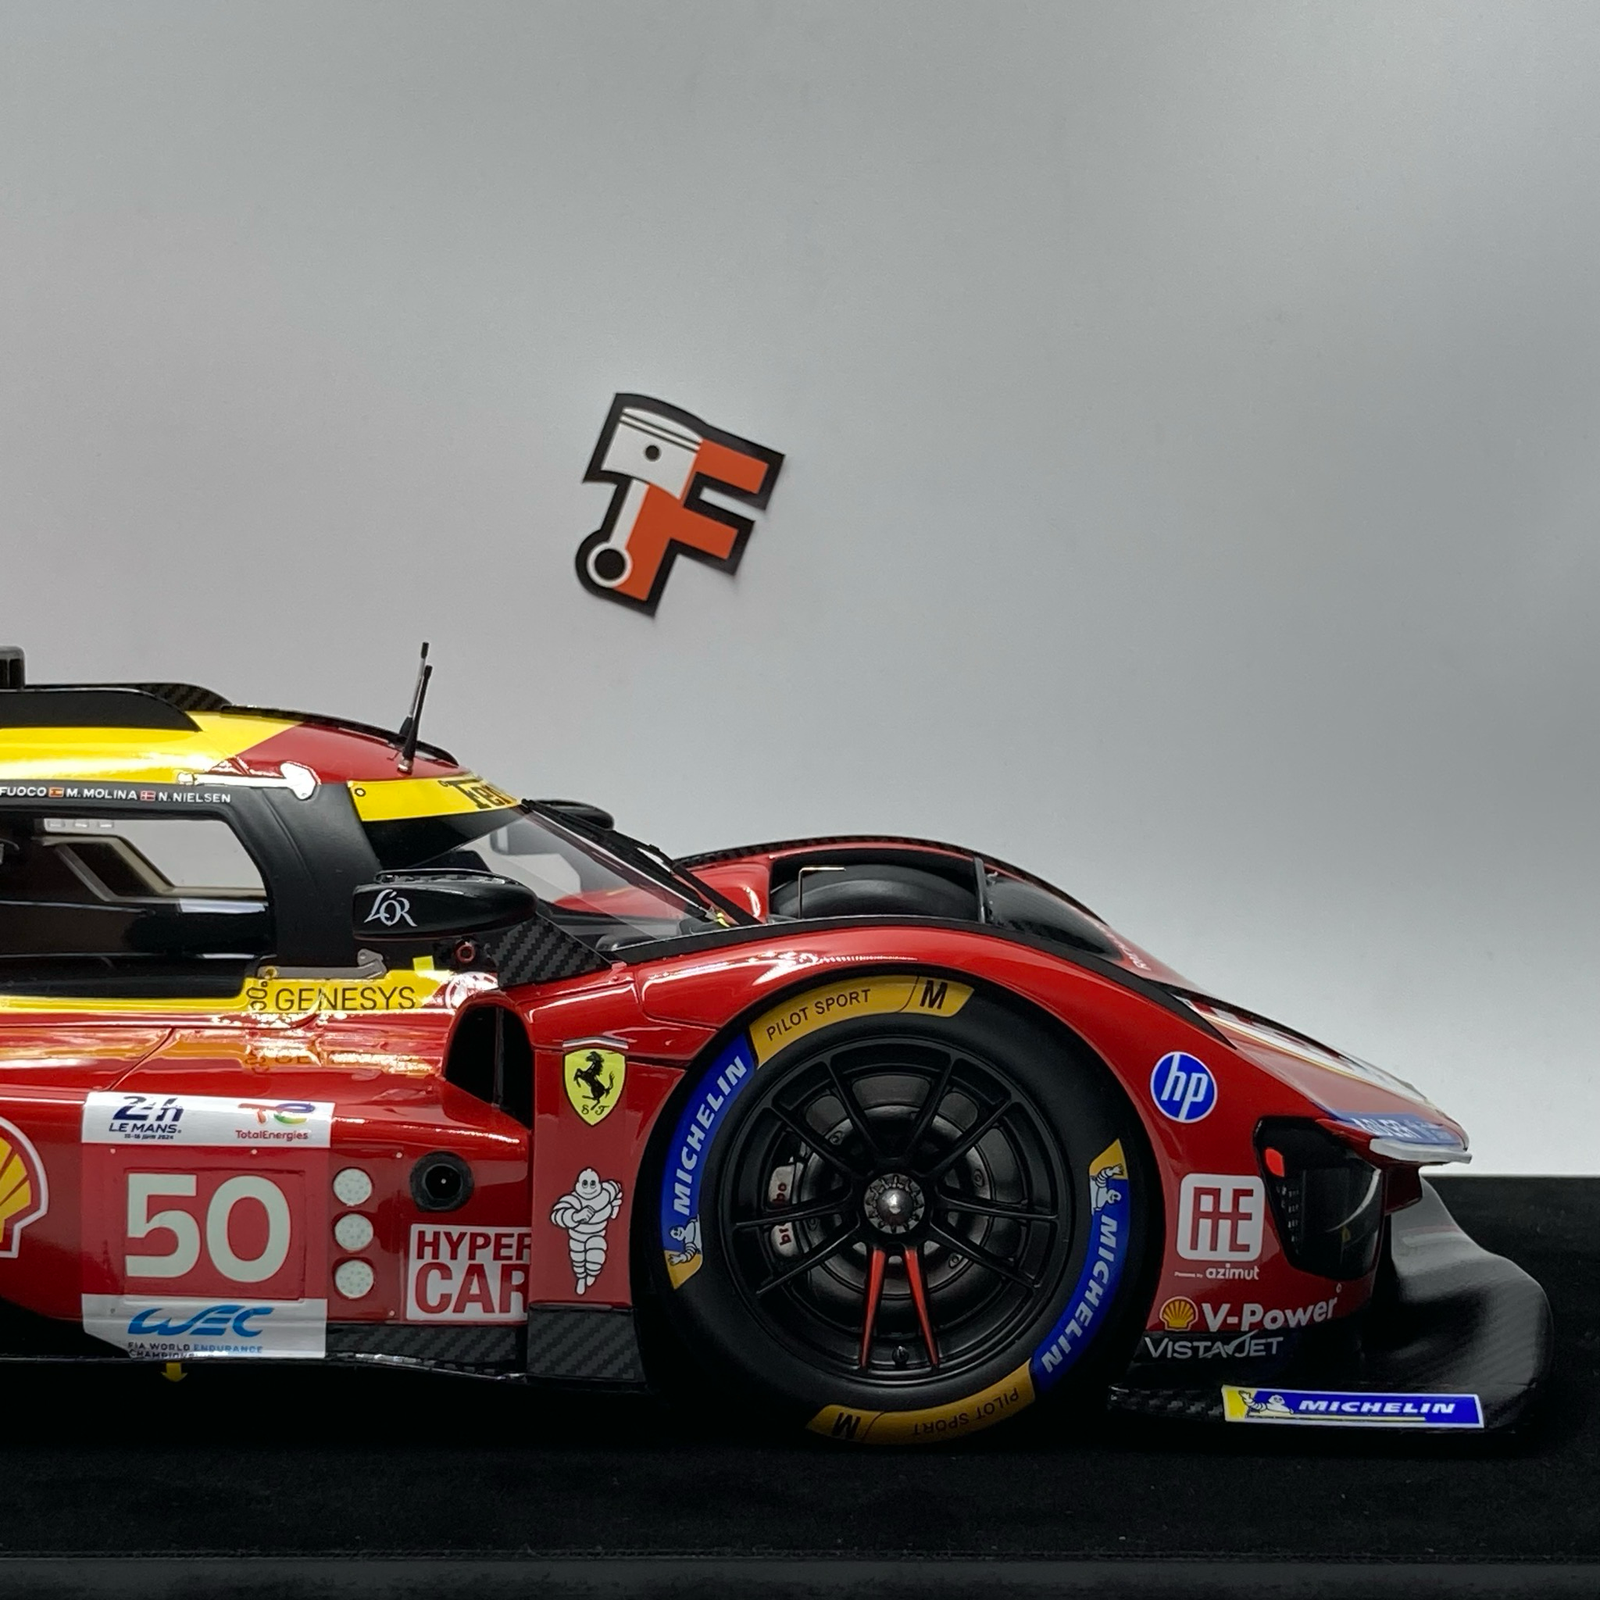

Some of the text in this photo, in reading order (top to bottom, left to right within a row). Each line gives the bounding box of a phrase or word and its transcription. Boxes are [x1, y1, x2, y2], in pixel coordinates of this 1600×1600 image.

[0, 787, 47, 797] FUOCO
[275, 986, 416, 1011] GENESYS
[919, 980, 948, 1010] M
[766, 989, 871, 1041] PILOT SPORT
[1161, 1052, 1208, 1121] hp
[109, 1122, 129, 1133] LE
[235, 1129, 308, 1142] TotalEnergies
[673, 1055, 747, 1216] MICHELIN
[125, 1173, 291, 1283] 50
[1205, 1263, 1260, 1280] azimut
[1041, 1214, 1118, 1373] MICHELIN
[128, 1304, 274, 1337] WEC
[1202, 1297, 1338, 1332] V-Power
[127, 1342, 264, 1354] FIA WORLD ENDURANCE
[913, 1387, 1019, 1436] PILOT SPORT
[1298, 1399, 1456, 1415] MICHELIN
